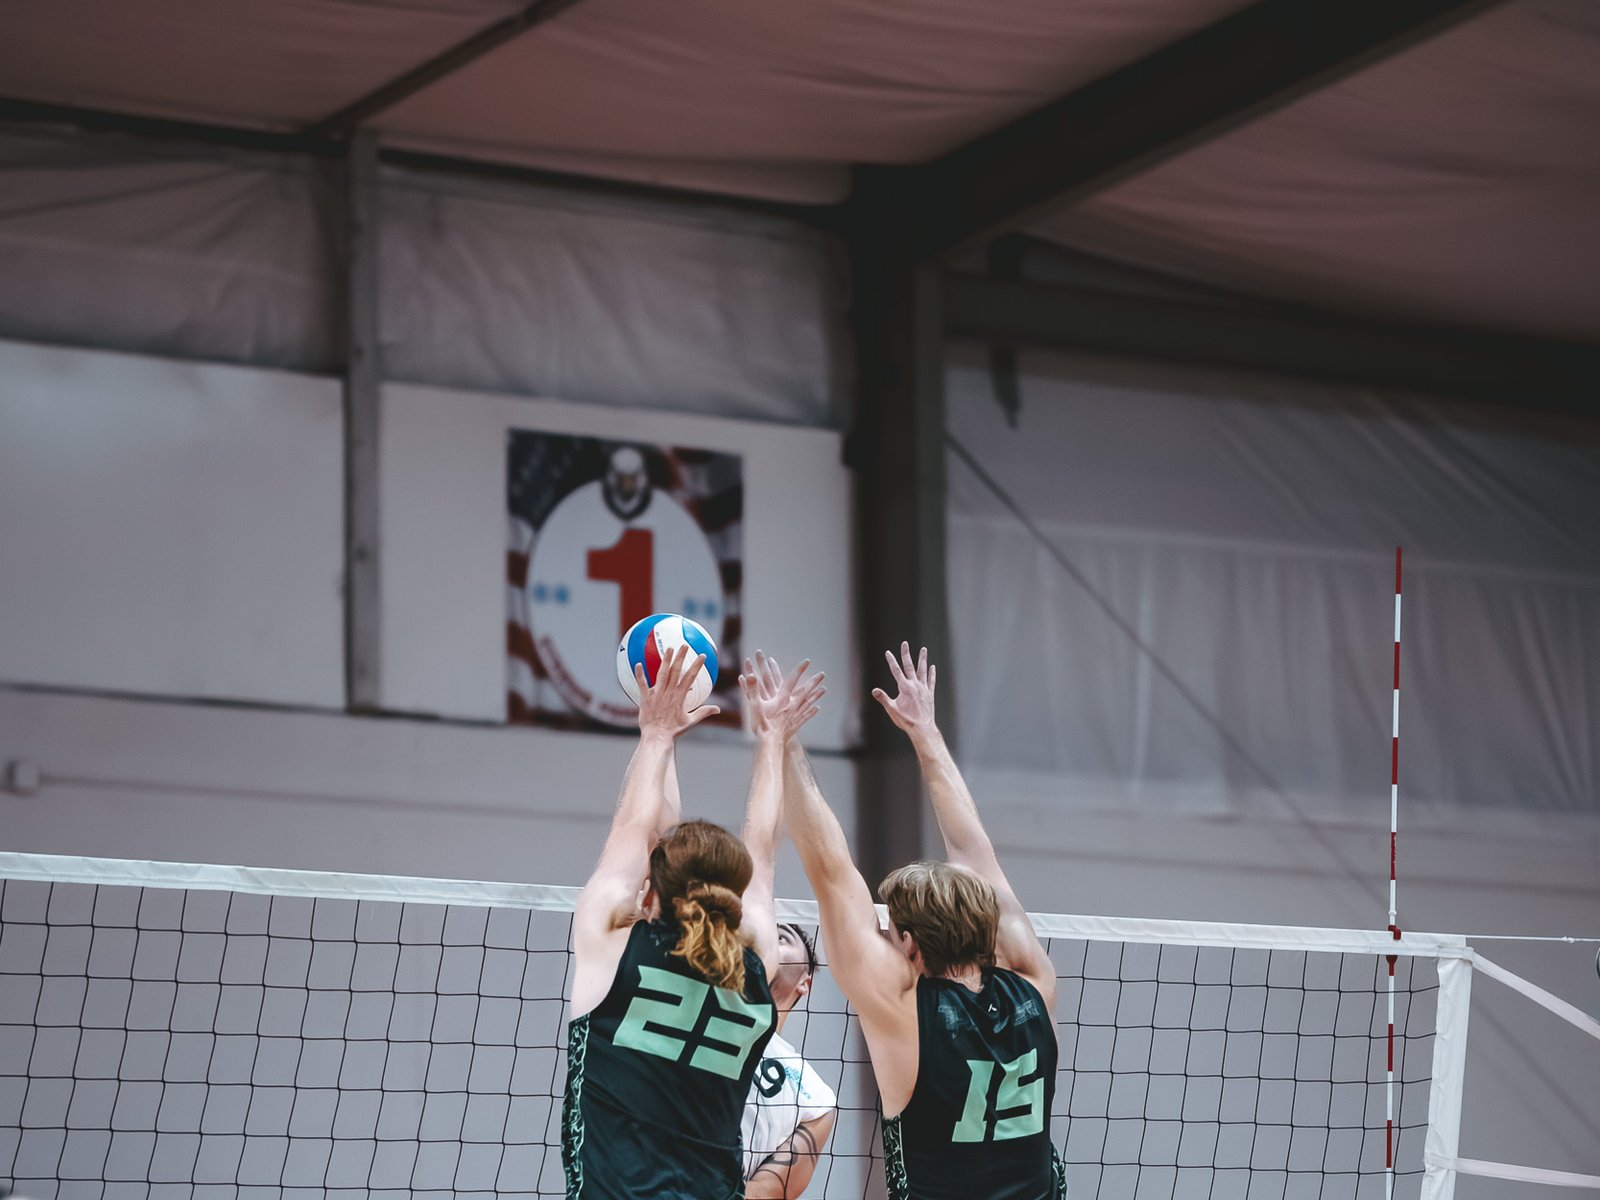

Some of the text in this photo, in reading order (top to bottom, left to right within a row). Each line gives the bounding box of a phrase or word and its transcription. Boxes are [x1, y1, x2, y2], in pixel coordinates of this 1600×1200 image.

[586, 528, 654, 644] 1
[612, 964, 772, 1081] 23
[951, 1047, 1045, 1143] 15
